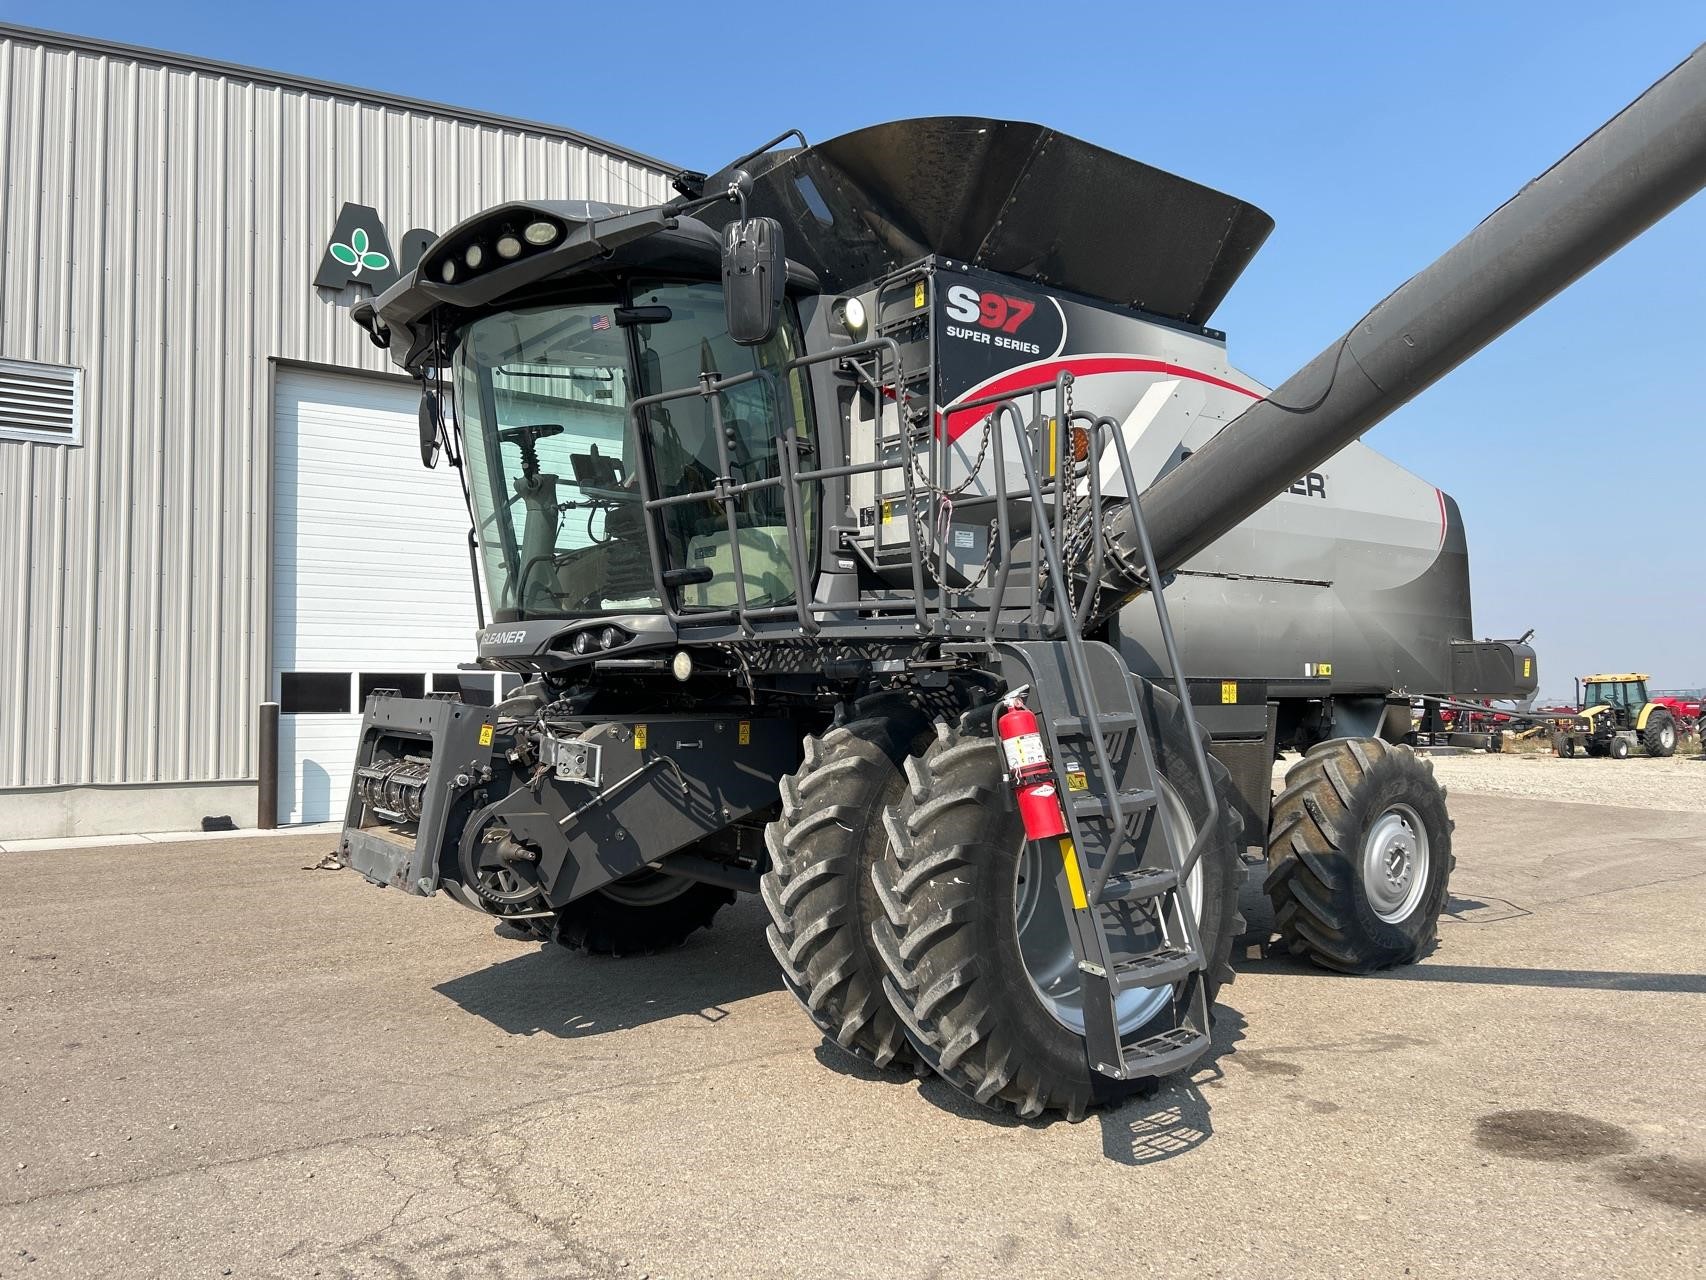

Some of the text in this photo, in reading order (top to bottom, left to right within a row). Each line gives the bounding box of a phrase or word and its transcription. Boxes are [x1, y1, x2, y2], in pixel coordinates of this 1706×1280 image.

[946, 285, 1035, 333] S97
[946, 325, 1040, 354] SUPER SERIES
